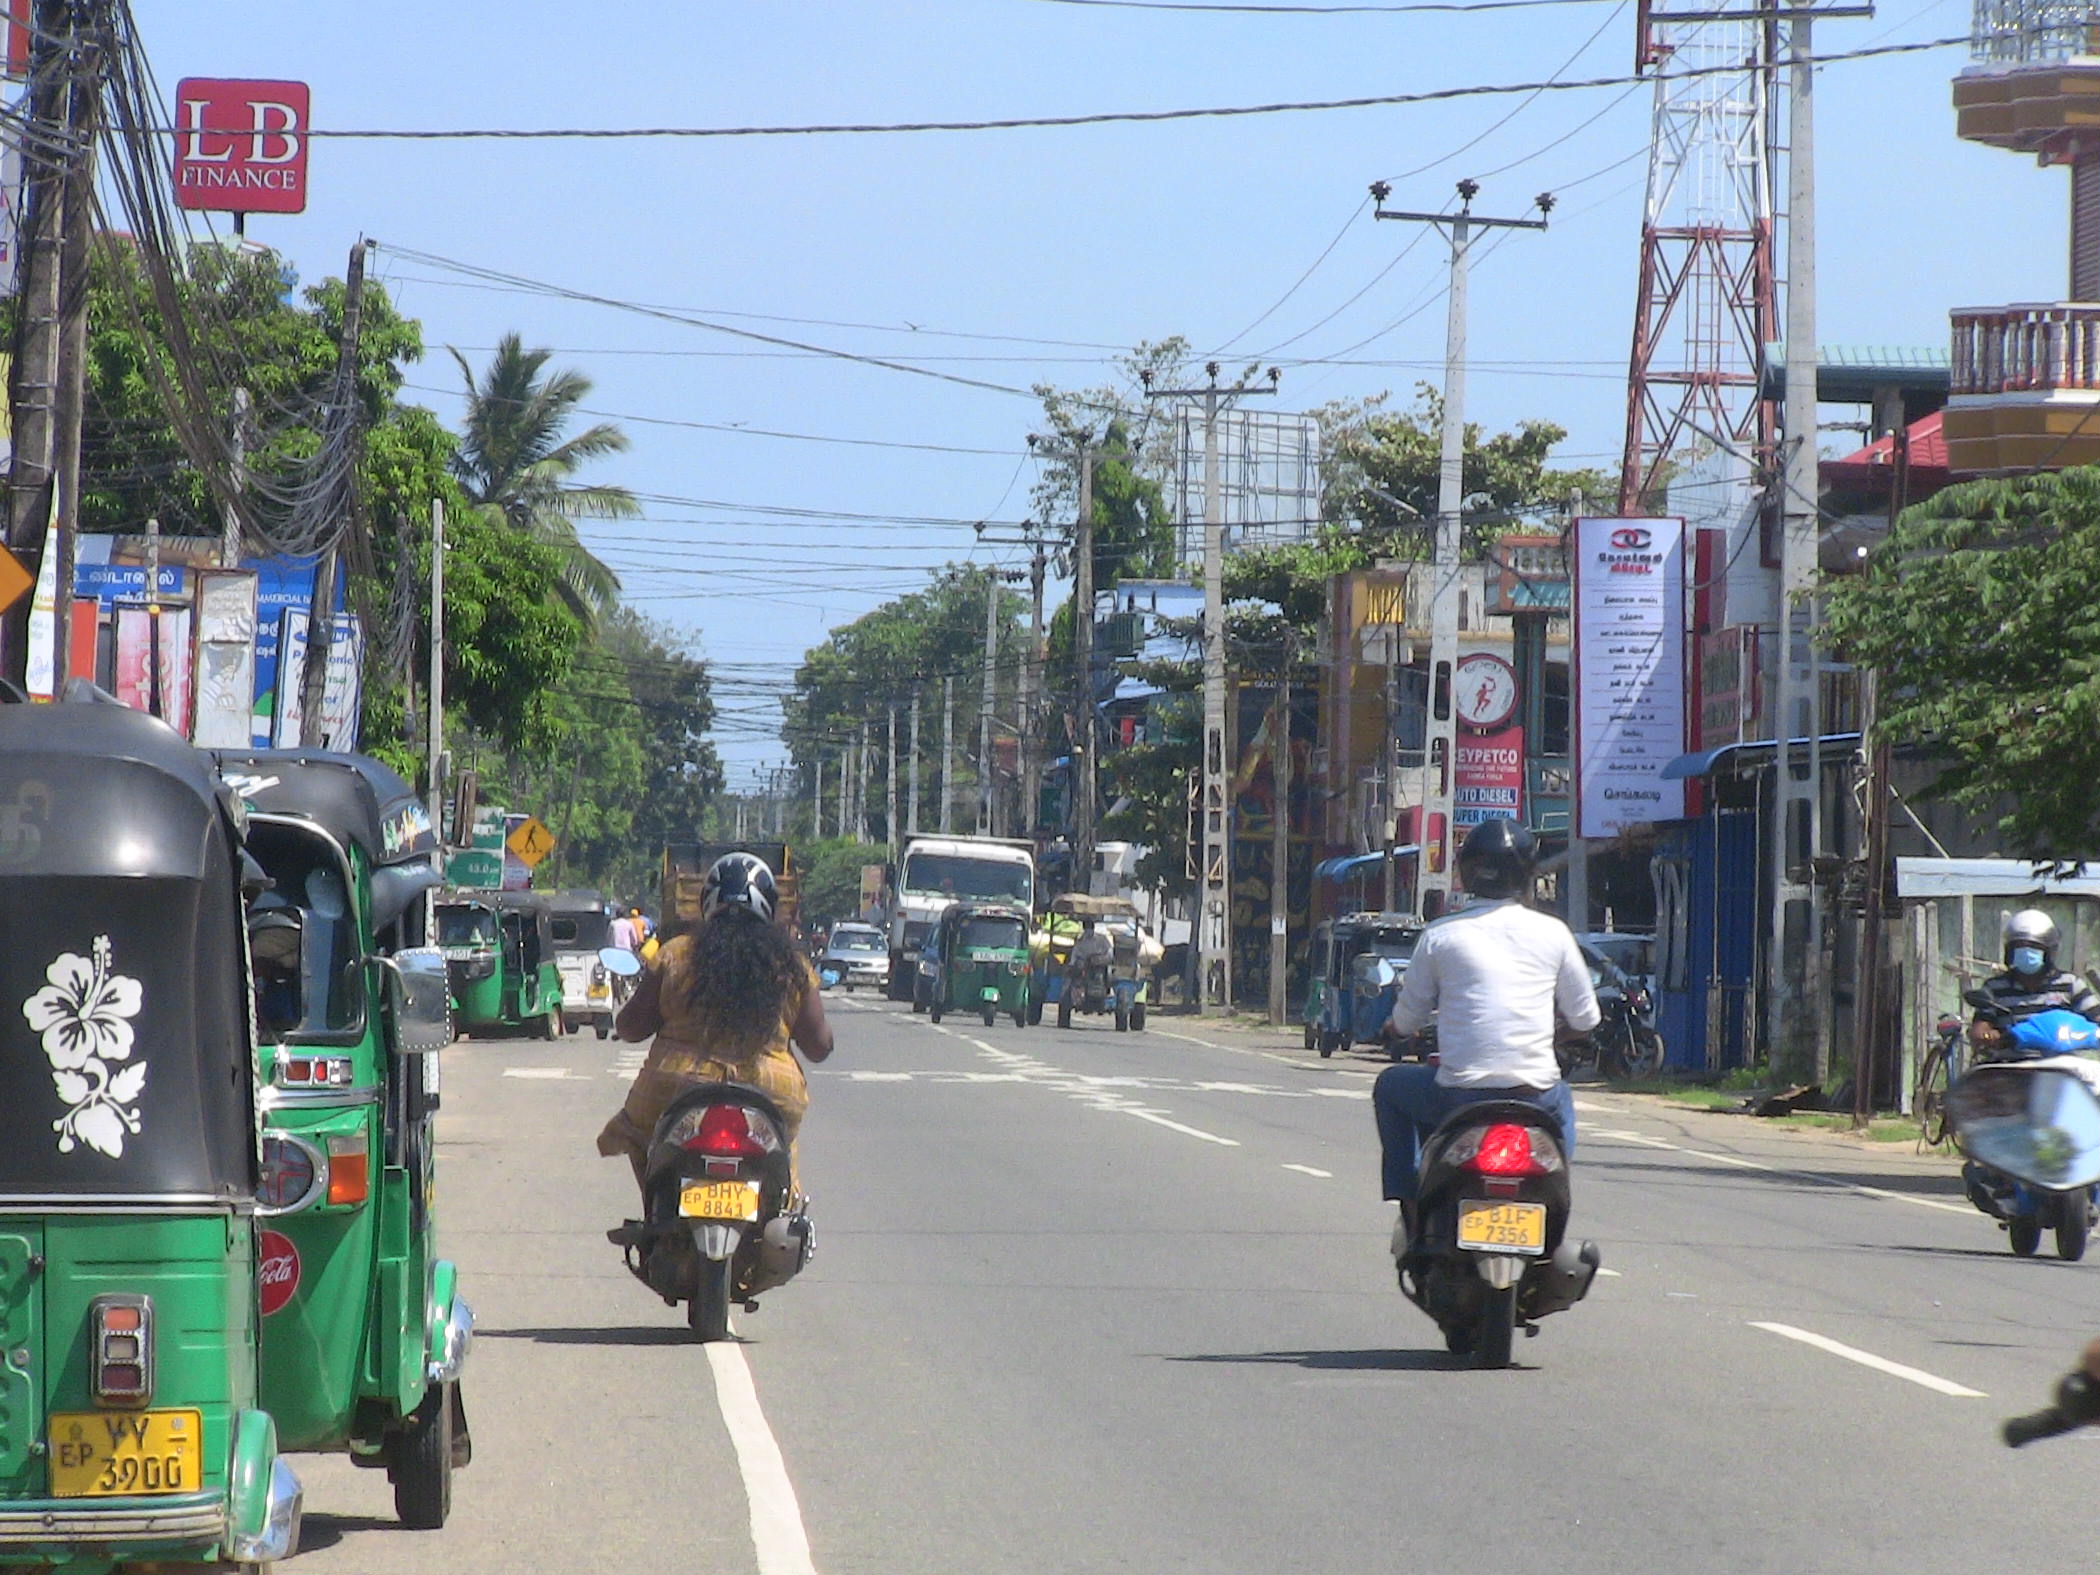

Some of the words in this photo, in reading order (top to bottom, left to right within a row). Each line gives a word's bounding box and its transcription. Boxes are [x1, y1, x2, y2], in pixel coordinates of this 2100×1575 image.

[181, 166, 297, 190] FINANCE
[1456, 747, 1518, 765] EYPETCO
[1479, 788, 1513, 803] DIESEL
[684, 1193, 702, 1204] EP
[703, 1201, 744, 1217] 8841
[1465, 1216, 1484, 1229] EP
[1486, 1225, 1528, 1243] 7356
[60, 1442, 93, 1468] EP
[101, 1455, 182, 1490] 3900
